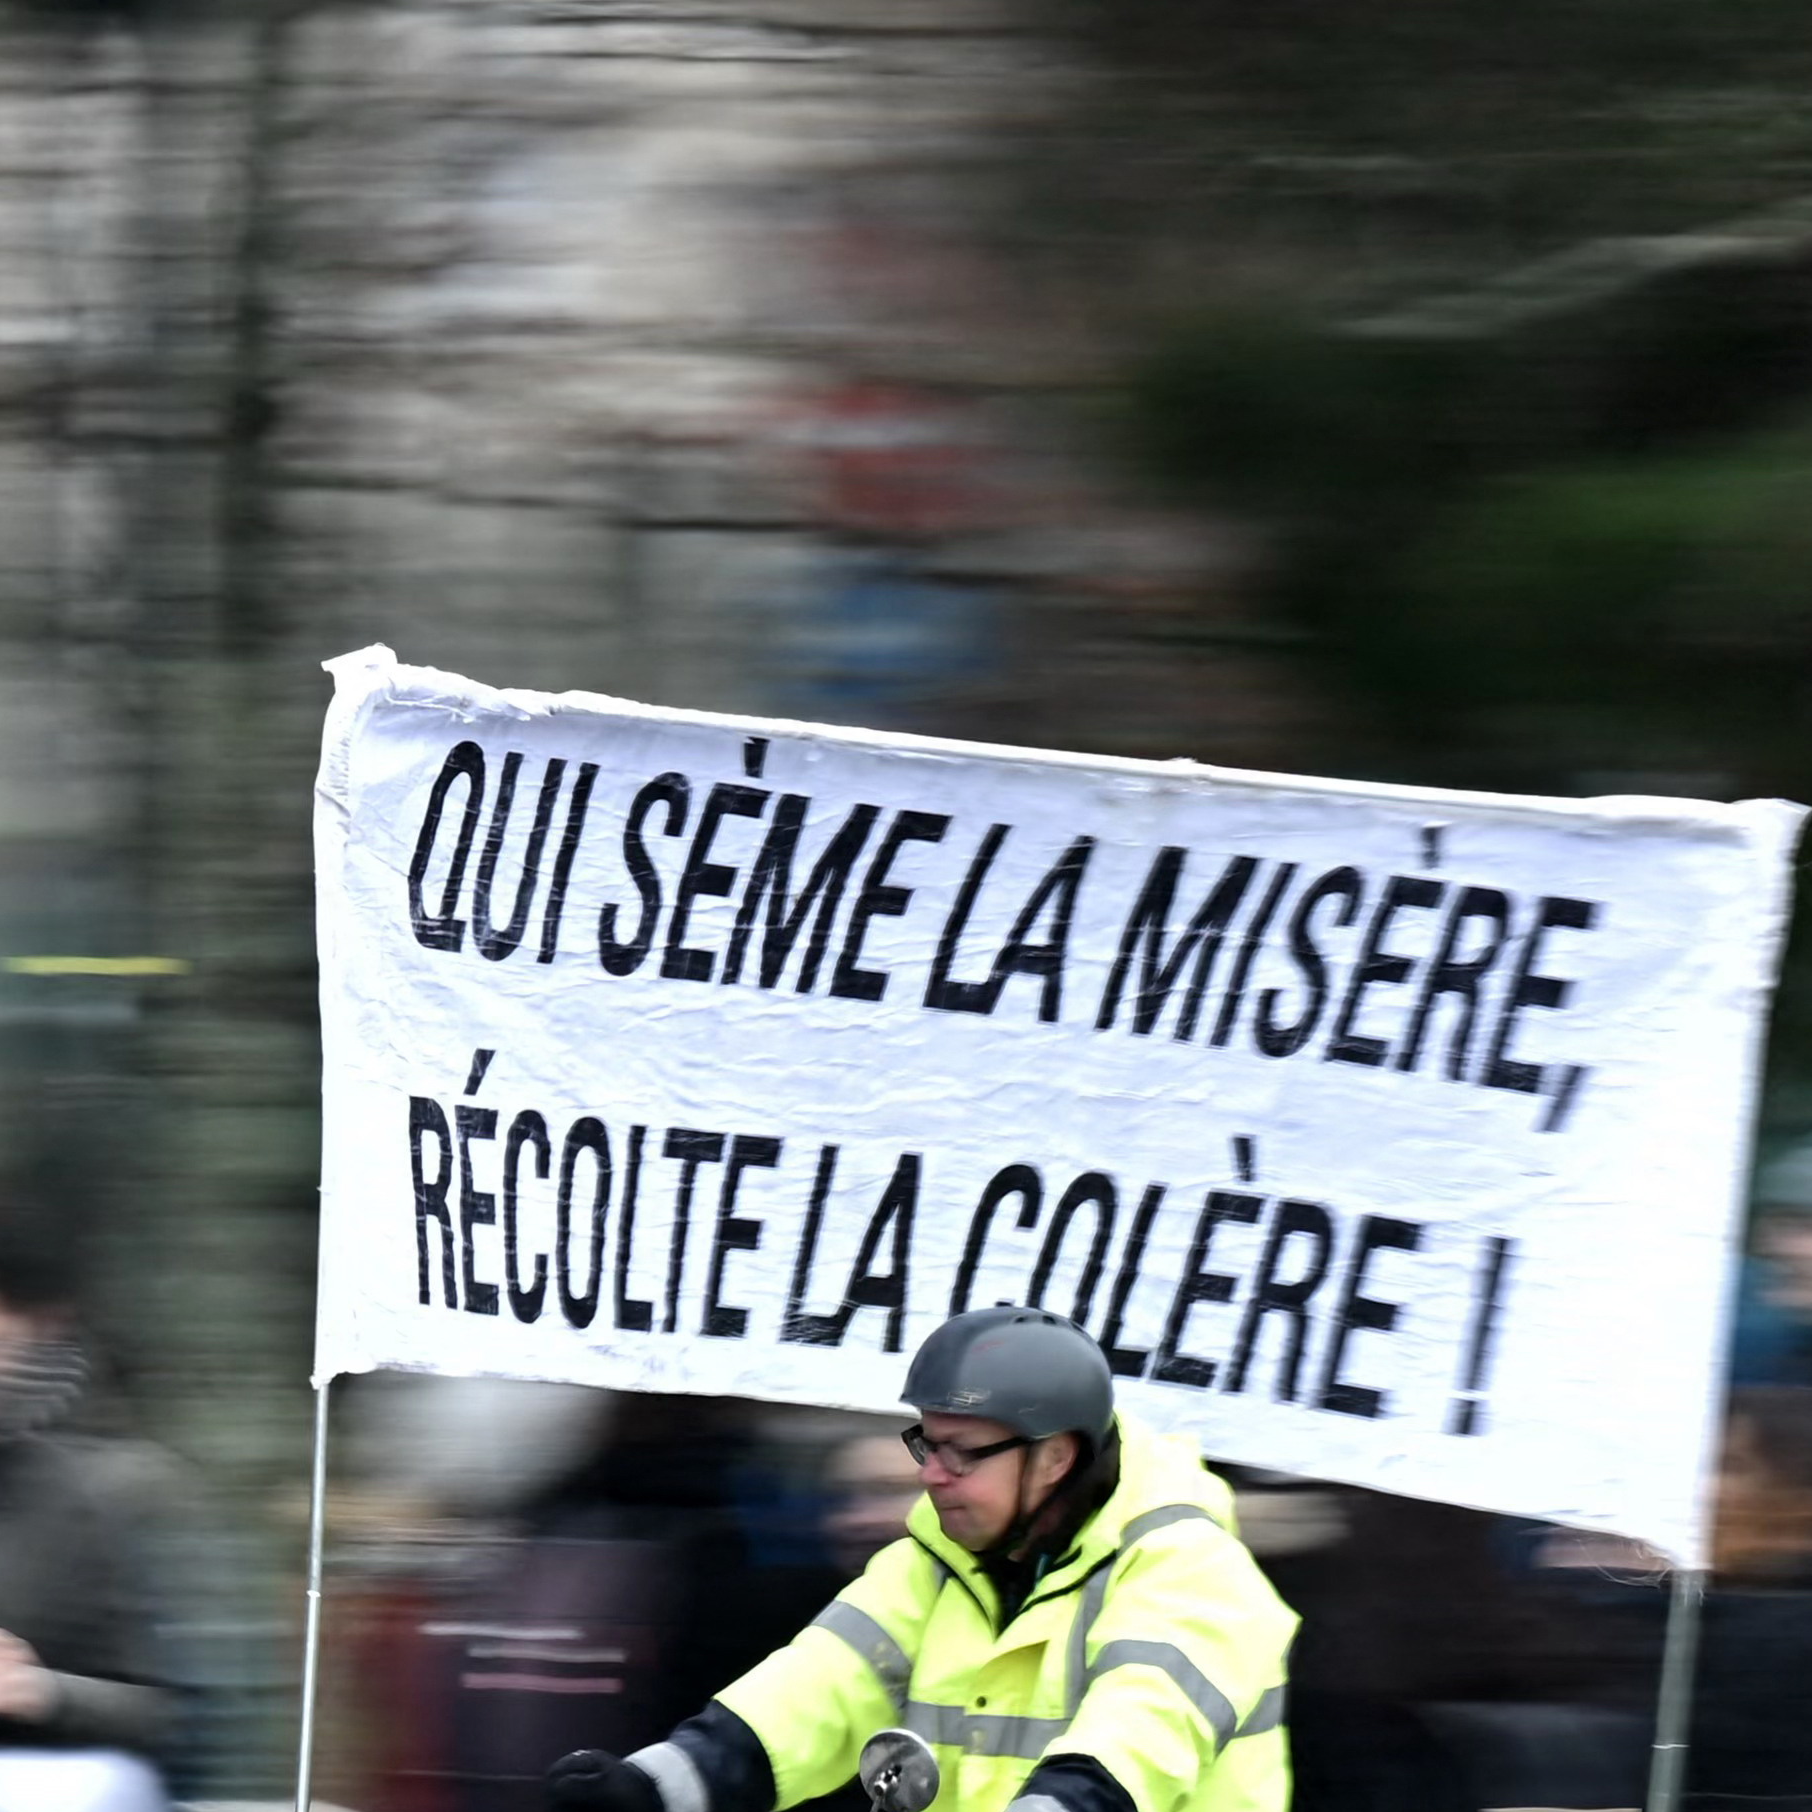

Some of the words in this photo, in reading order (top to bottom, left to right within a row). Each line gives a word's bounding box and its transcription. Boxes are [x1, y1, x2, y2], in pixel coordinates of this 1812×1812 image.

[406, 740, 601, 966] QUI
[596, 736, 955, 1004] SÈME
[922, 822, 1098, 1024] LA
[1093, 825, 1606, 1133] MISÈRE,
[407, 1048, 784, 1340] RÉCOLTE
[780, 1144, 922, 1355] LA
[947, 1136, 1426, 1420] COLÈRE
[1452, 1236, 1518, 1438] !
